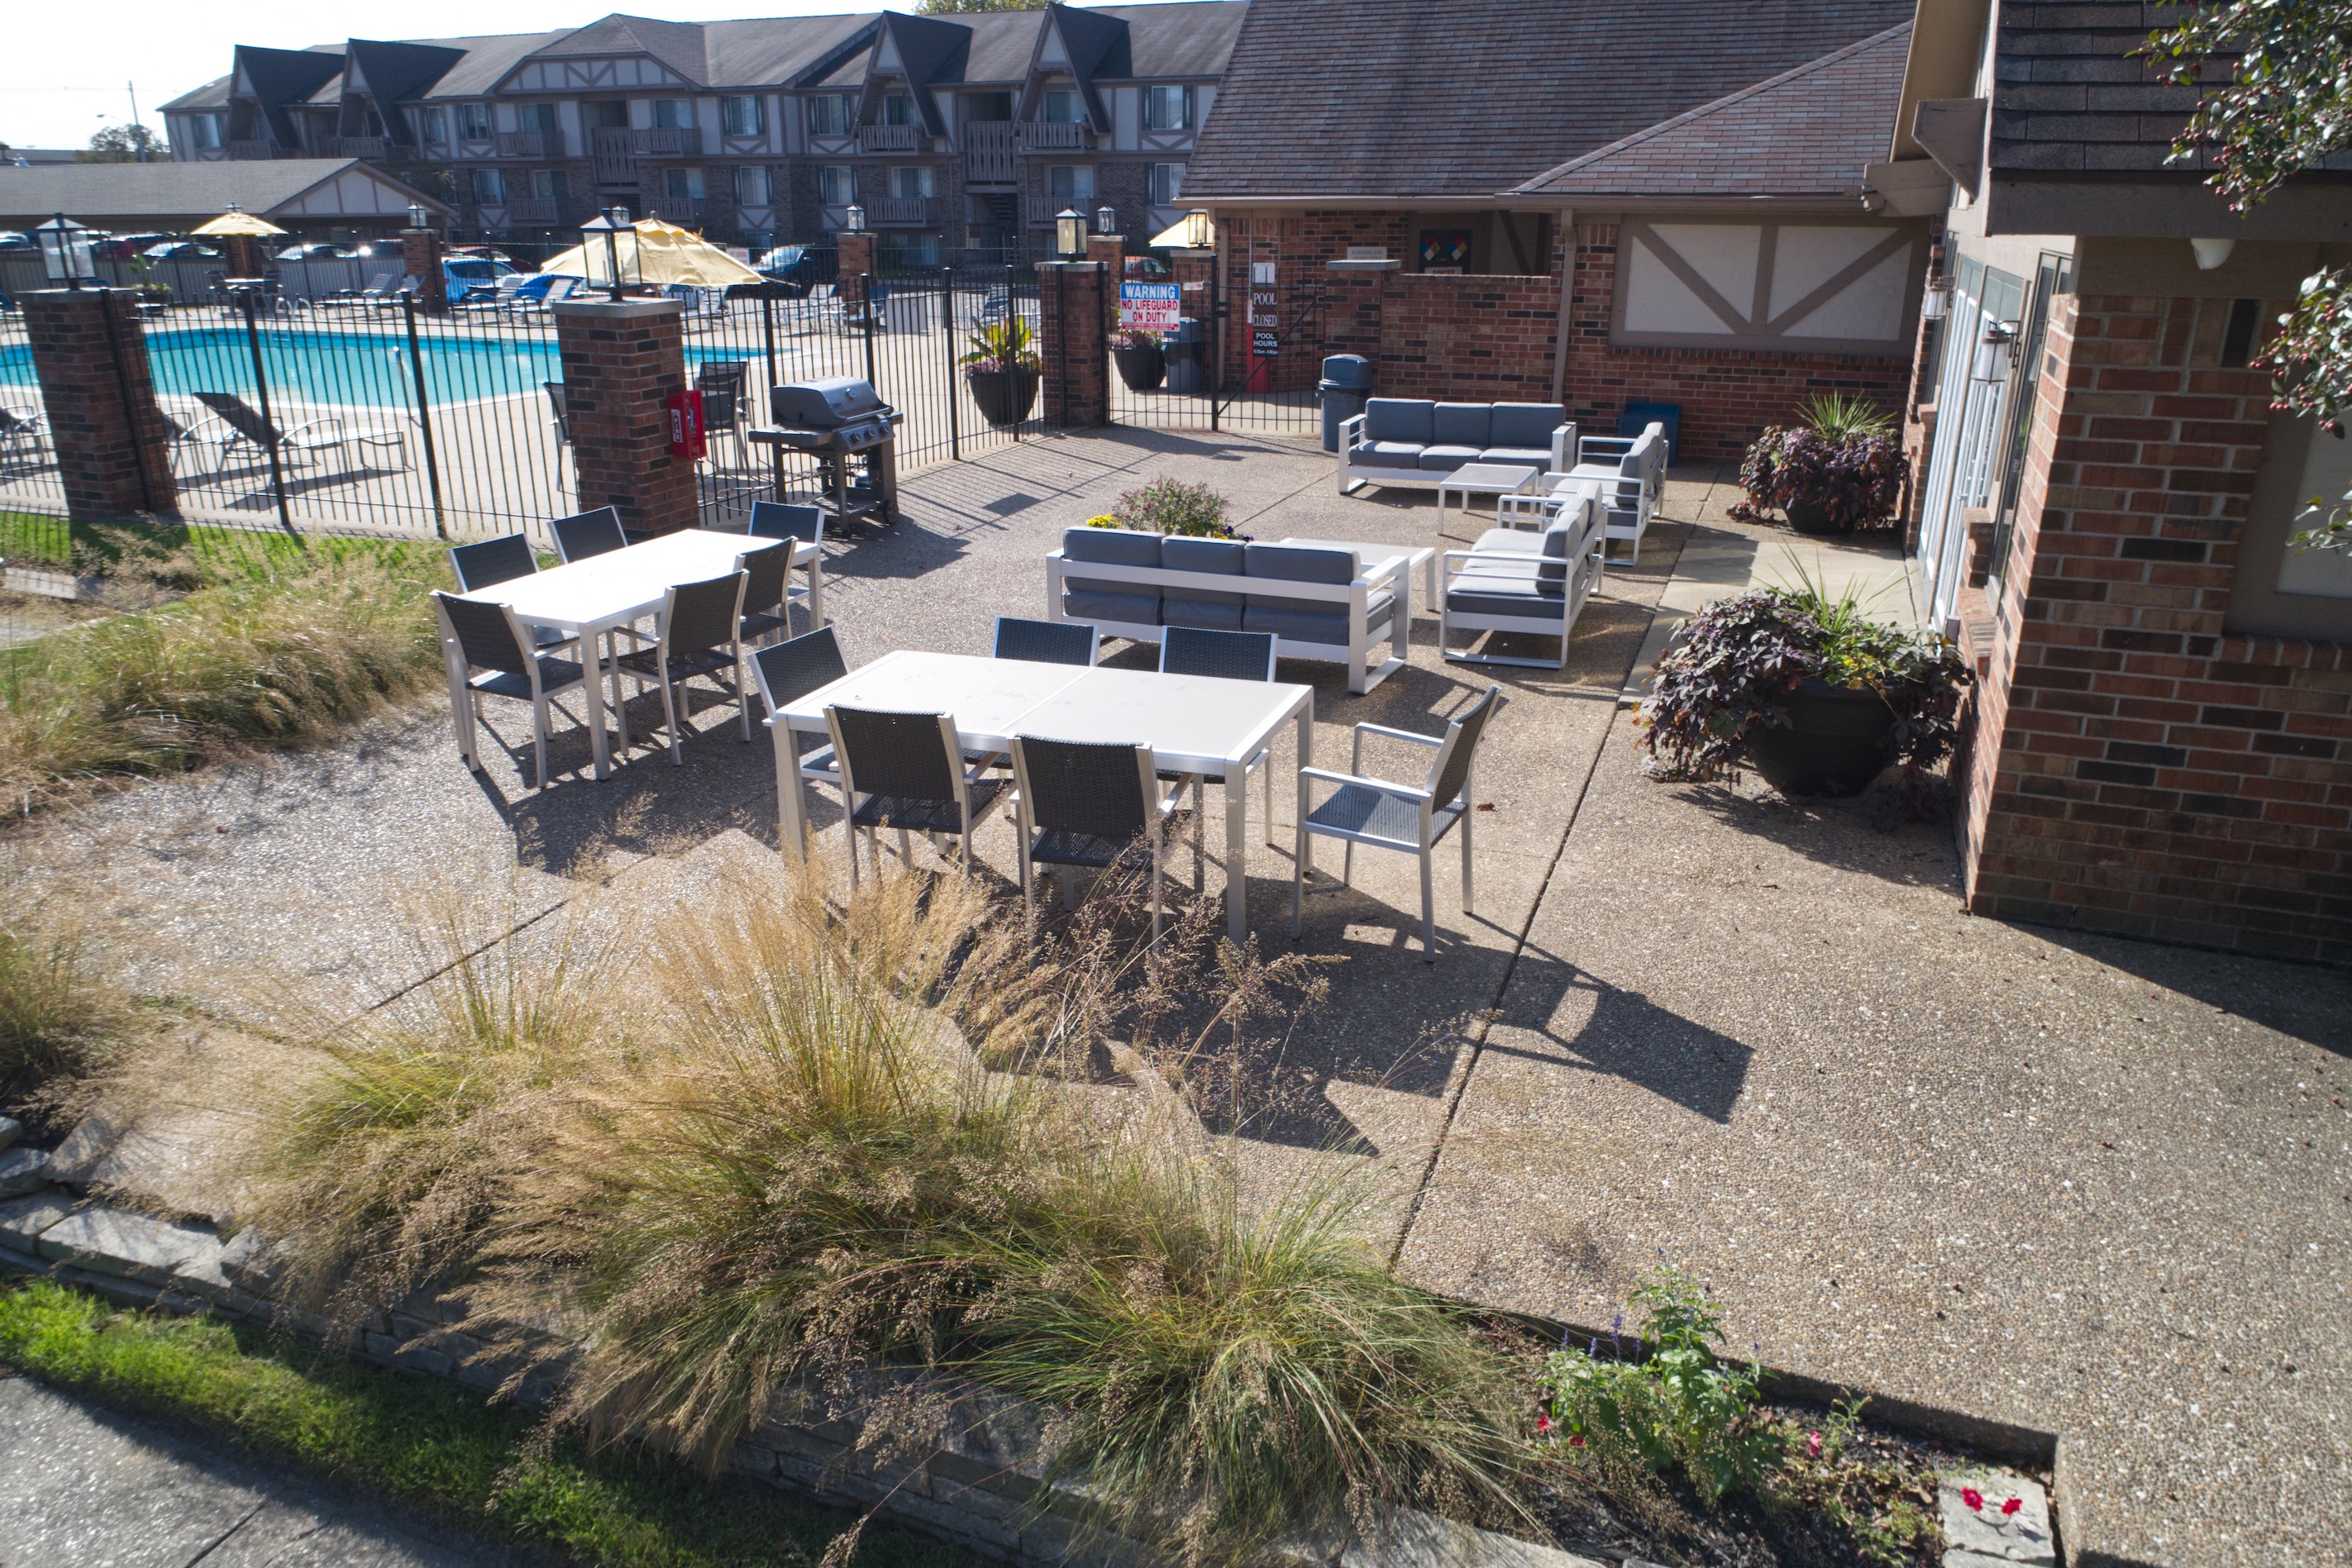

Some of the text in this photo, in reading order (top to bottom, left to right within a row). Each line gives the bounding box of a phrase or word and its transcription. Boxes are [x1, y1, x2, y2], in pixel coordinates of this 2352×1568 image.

[1125, 285, 1176, 298] WARNING
[1122, 299, 1178, 311] NO LIFEGUARD
[1253, 293, 1277, 305] POOL
[1133, 312, 1166, 322] ON DUTY
[1252, 315, 1277, 326] CLOSED
